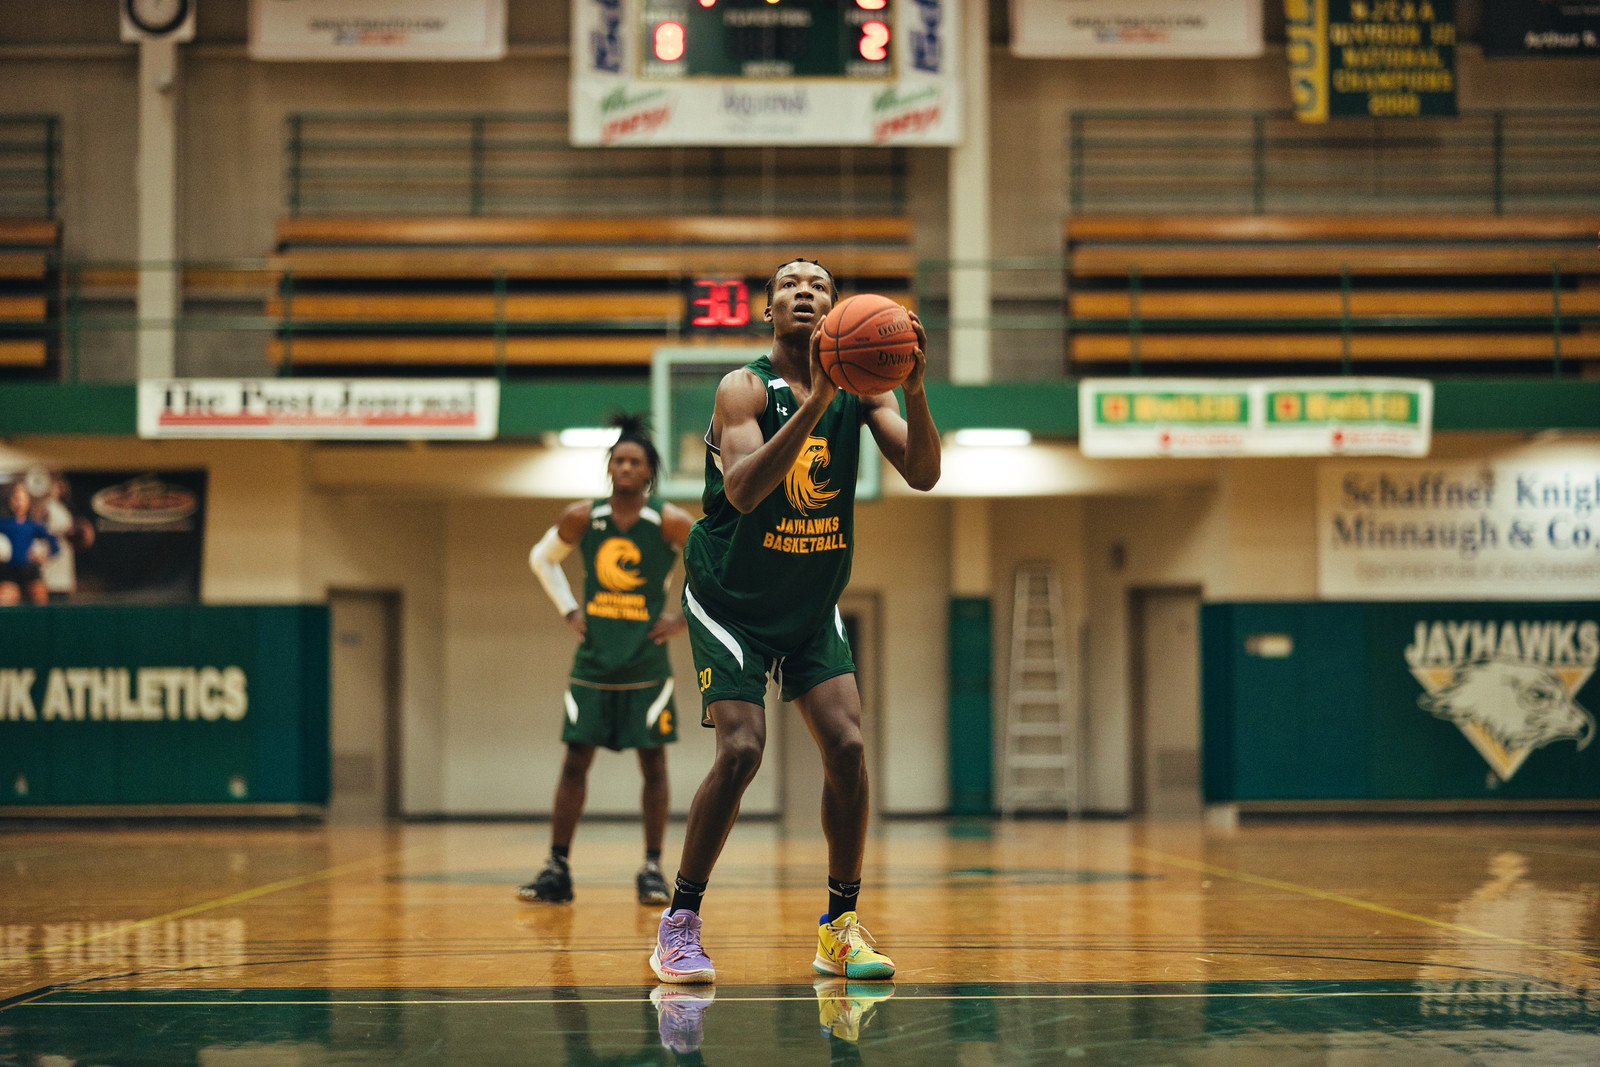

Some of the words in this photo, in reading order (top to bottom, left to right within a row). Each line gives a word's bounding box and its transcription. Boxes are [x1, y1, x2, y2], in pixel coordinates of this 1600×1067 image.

[692, 280, 749, 326] 30
[763, 531, 847, 553] BASKETBALL
[776, 516, 839, 535] JAYHAWKS
[1332, 514, 1498, 560] Minnaugh
[1508, 521, 1536, 549] &
[1404, 620, 1600, 667] JAYHAWKS
[41, 665, 248, 722] ATHLETICS
